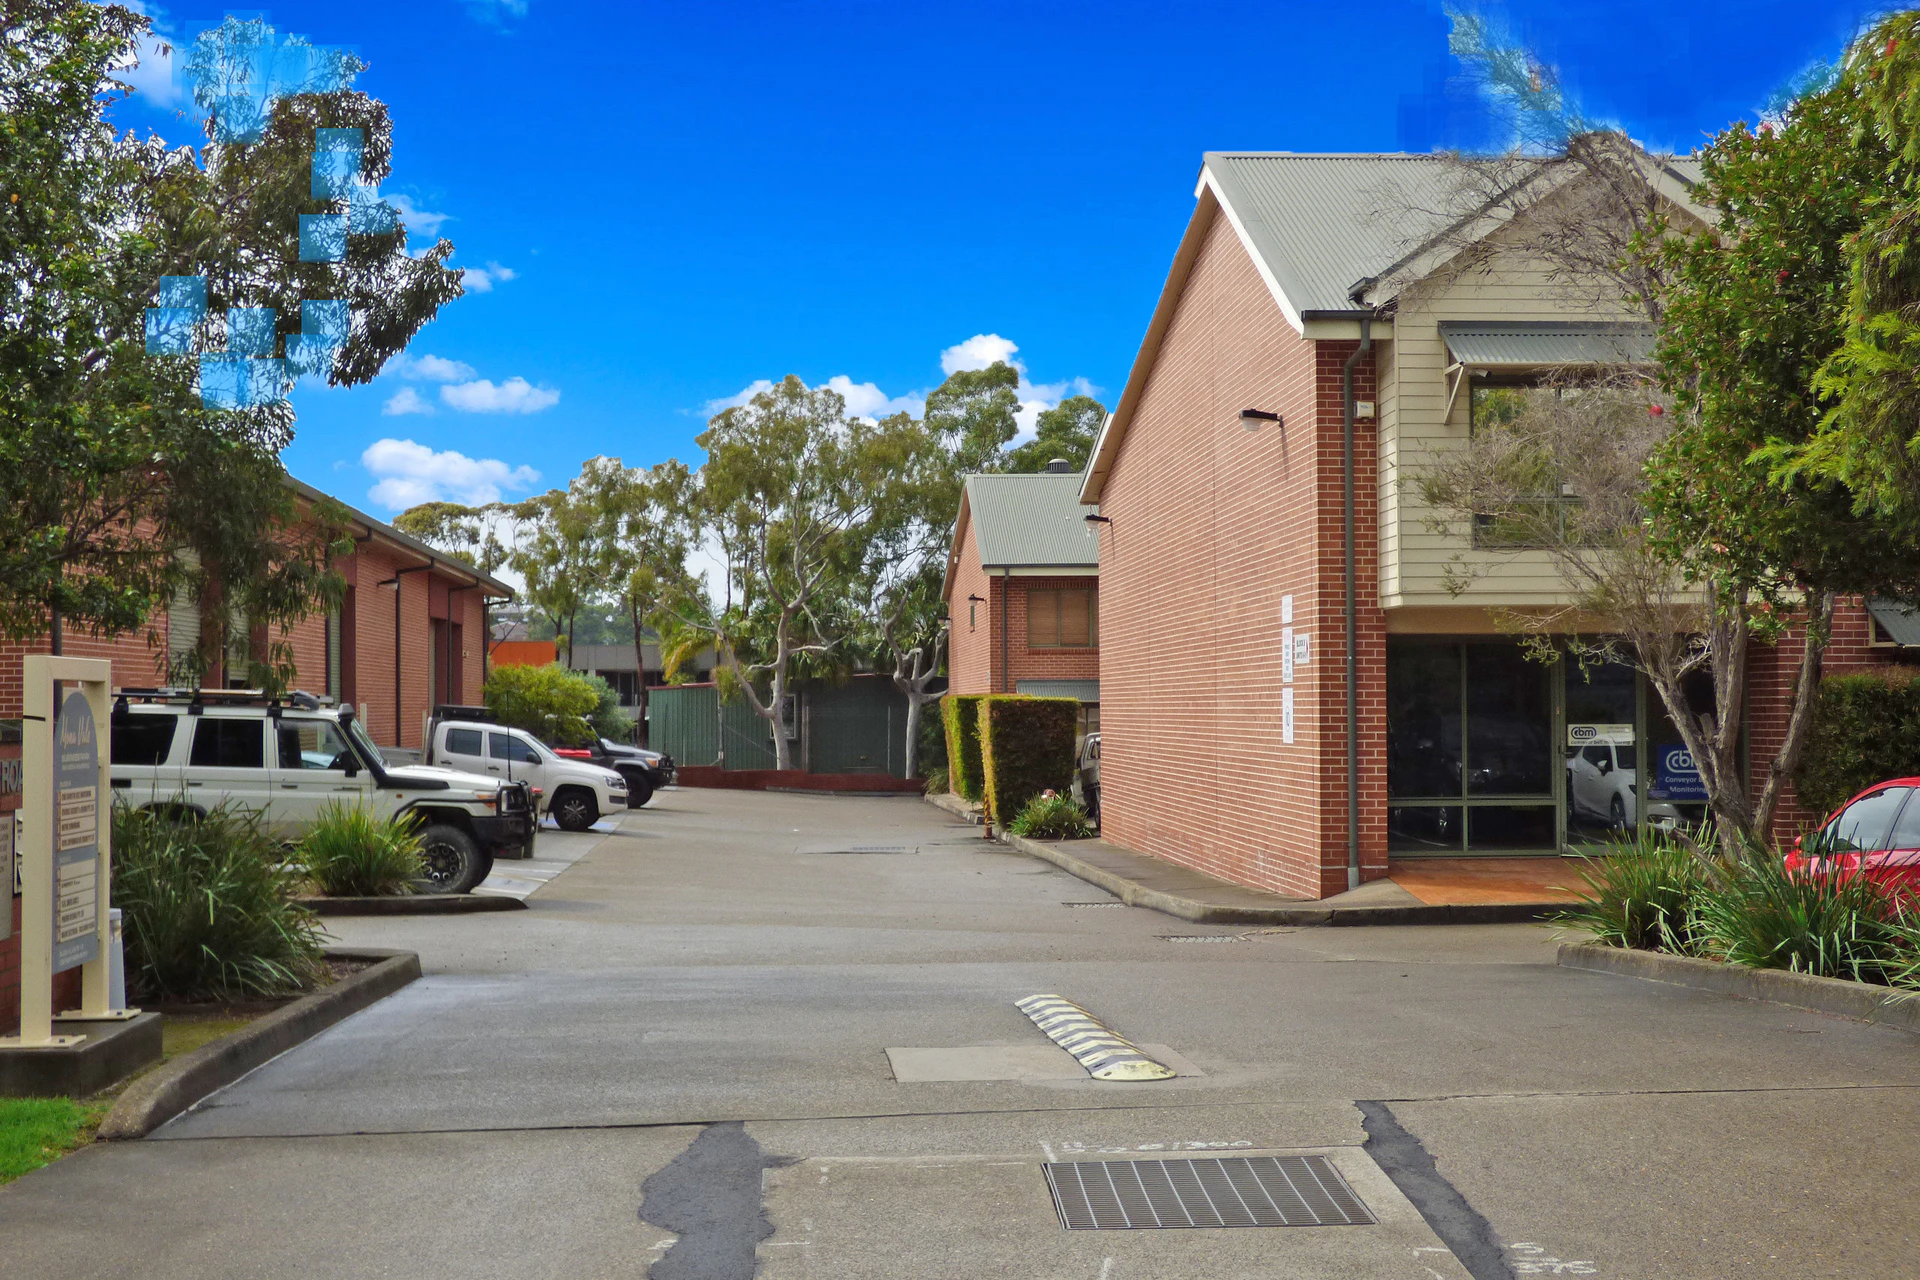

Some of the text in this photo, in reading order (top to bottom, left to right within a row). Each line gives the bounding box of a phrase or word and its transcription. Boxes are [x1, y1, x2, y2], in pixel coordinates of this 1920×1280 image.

[1574, 727, 1594, 737] cbm
[1672, 751, 1696, 768] cb
[1665, 776, 1697, 784] Conveyor
